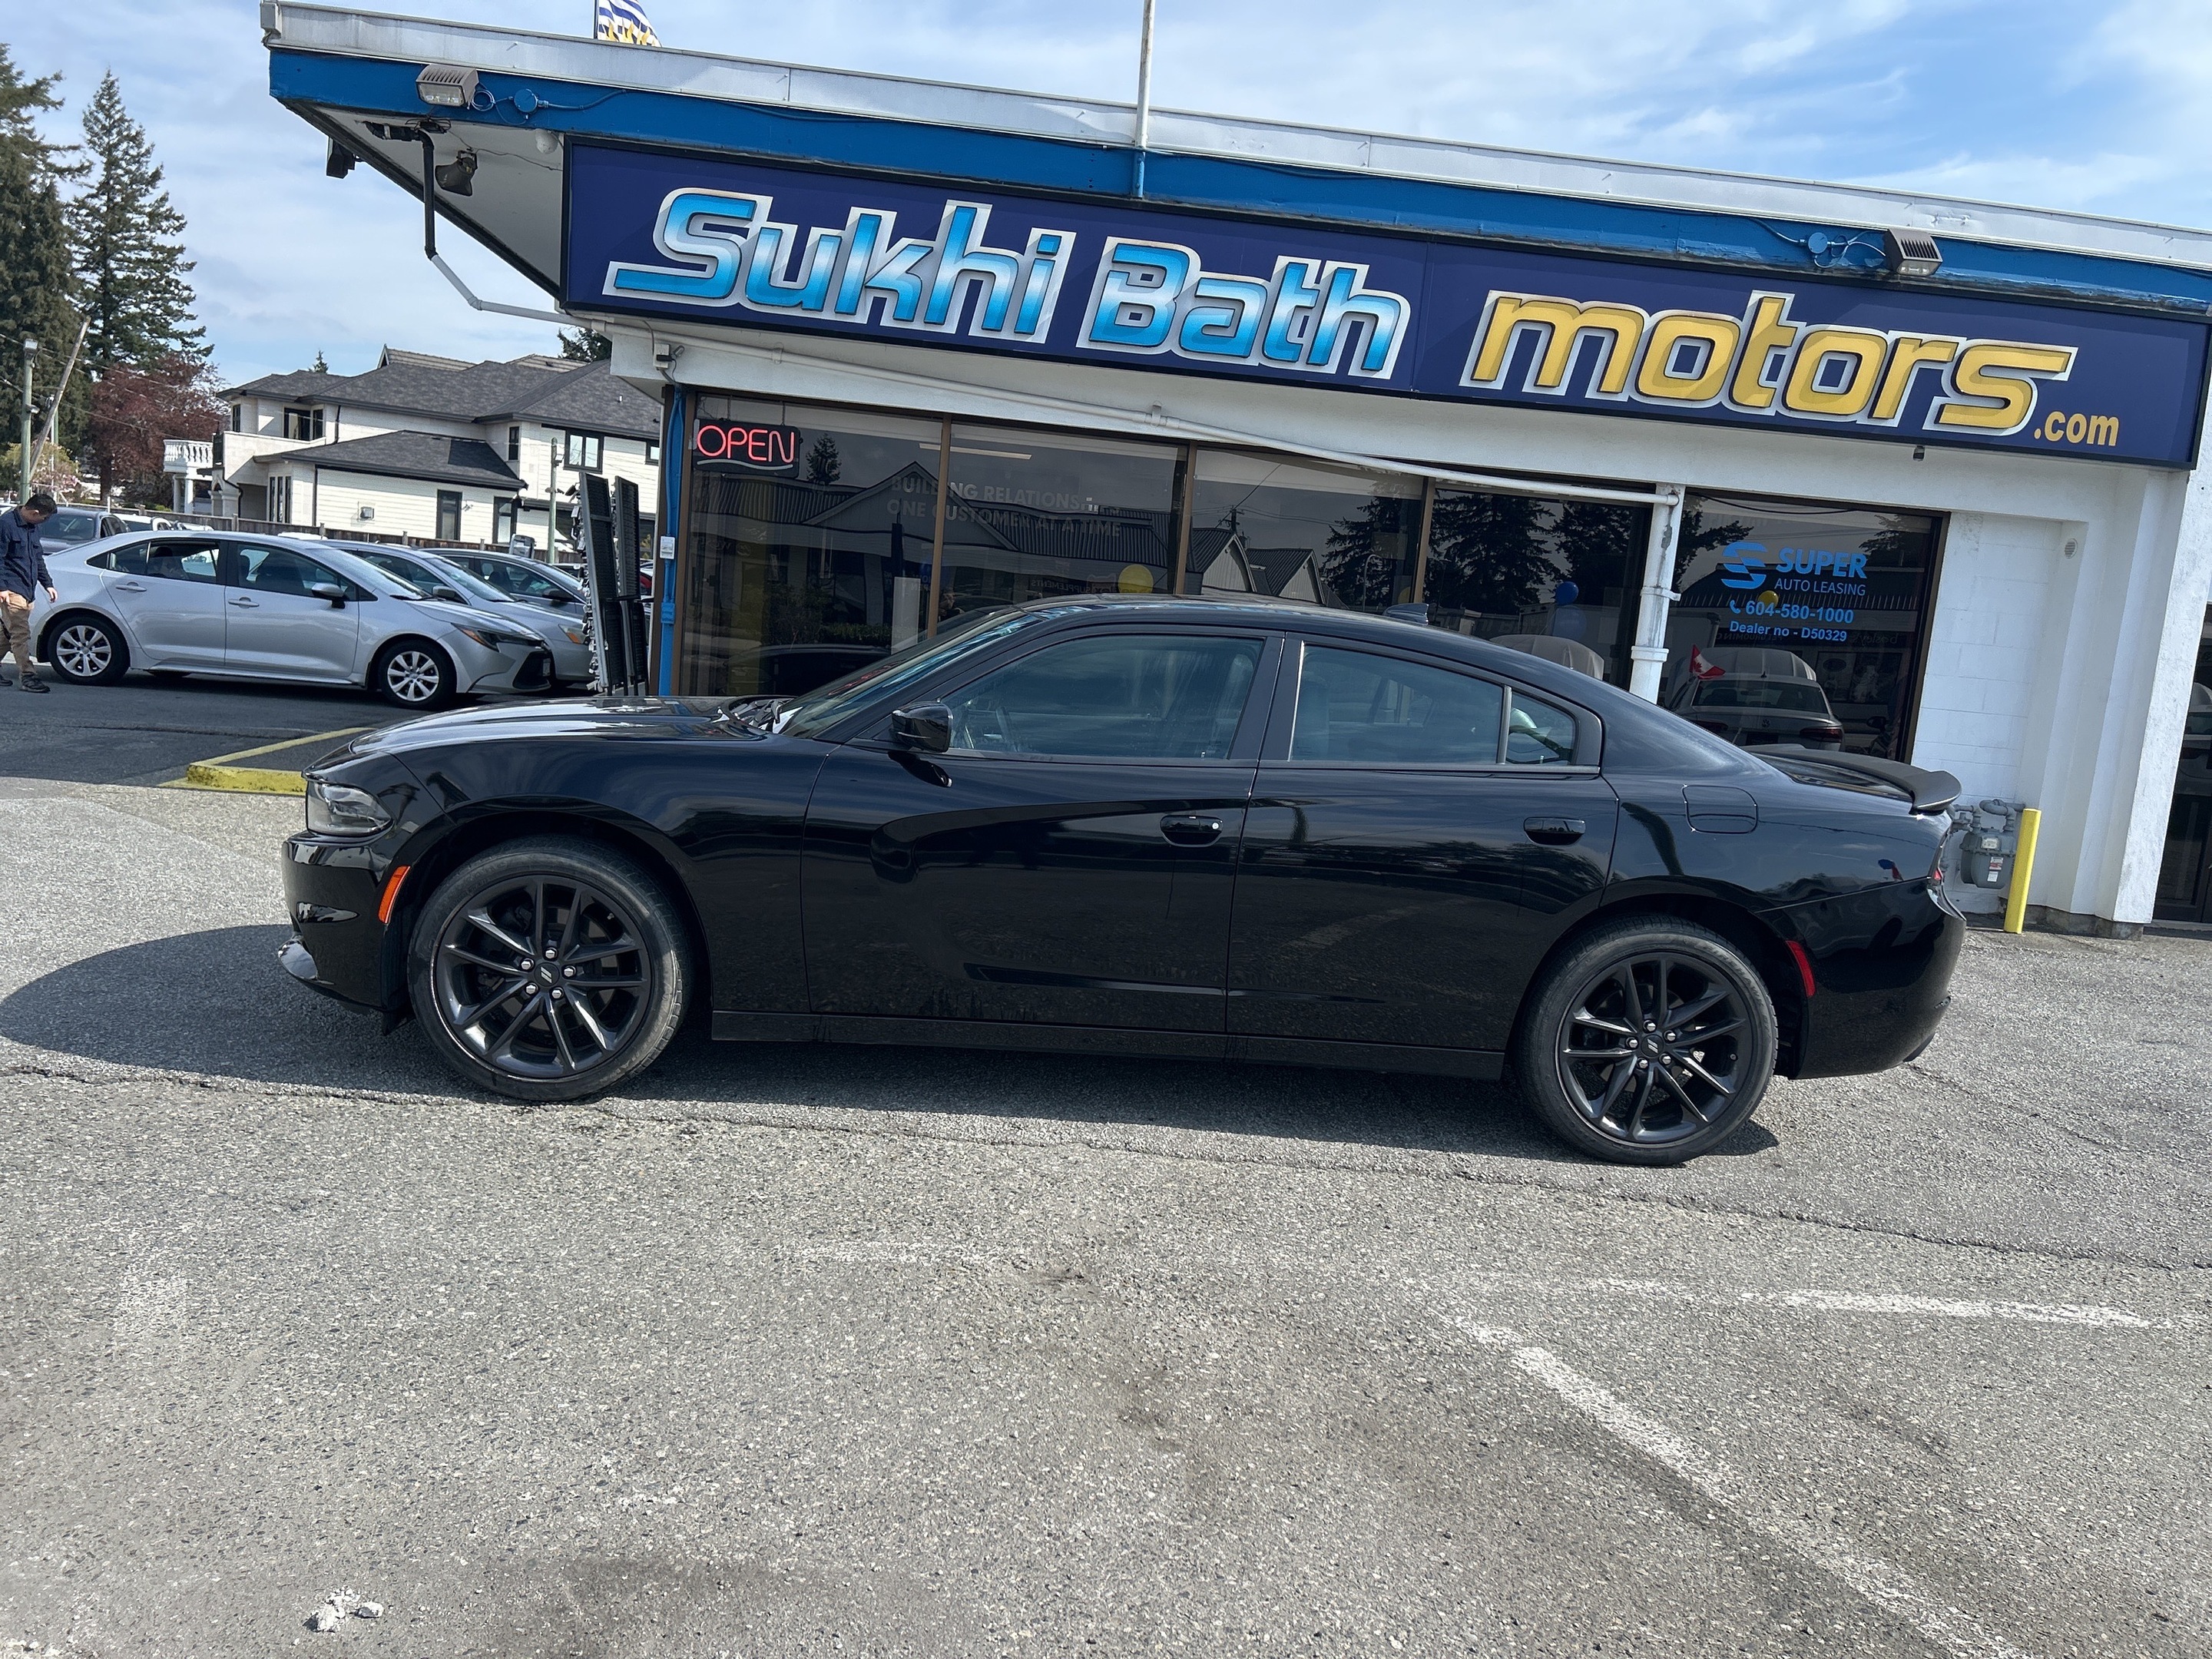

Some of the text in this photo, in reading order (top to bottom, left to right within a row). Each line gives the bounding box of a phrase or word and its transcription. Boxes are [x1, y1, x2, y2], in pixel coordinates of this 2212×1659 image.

[603, 187, 2120, 447] Sukhi Bath motors .com
[697, 425, 796, 464] OPEN
[886, 498, 926, 518] ONE
[1776, 547, 1868, 578] SUPER
[1774, 578, 1866, 596] AUTO LEASING
[1745, 600, 1855, 624] 604-580-1000
[1730, 621, 1771, 635] Dealer
[1773, 627, 1790, 637] no
[1801, 627, 1847, 642] D50329
